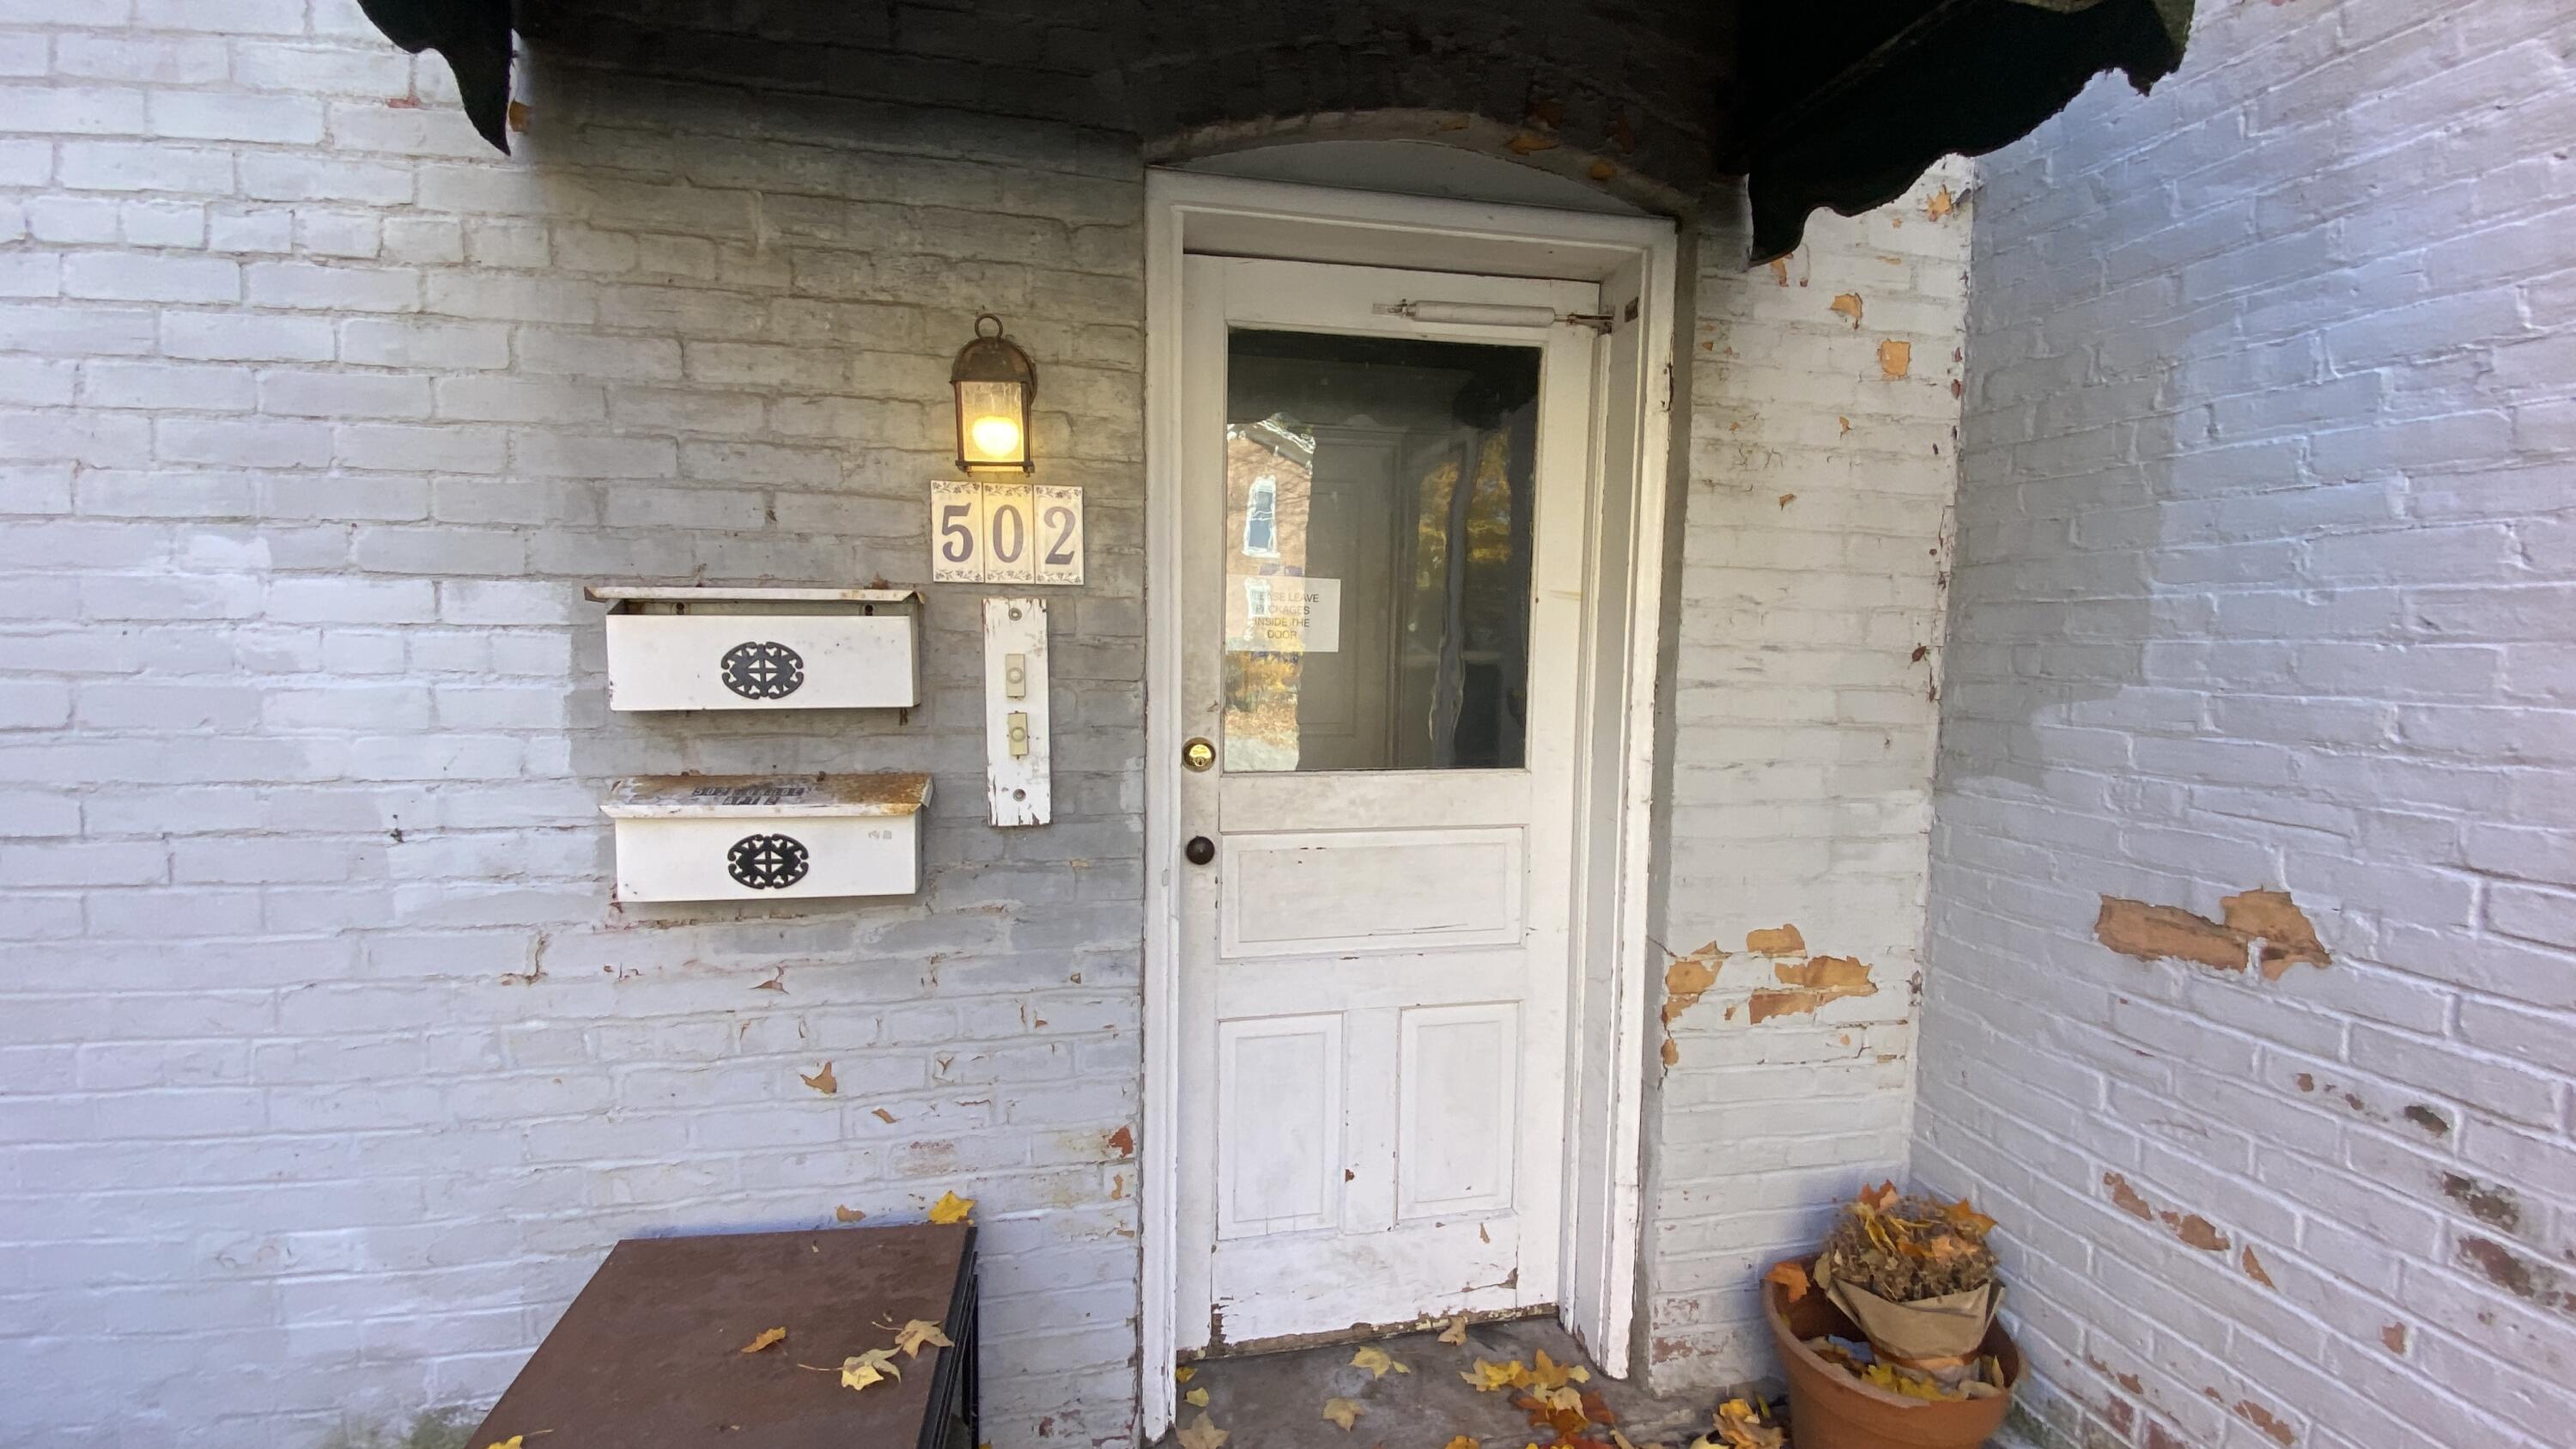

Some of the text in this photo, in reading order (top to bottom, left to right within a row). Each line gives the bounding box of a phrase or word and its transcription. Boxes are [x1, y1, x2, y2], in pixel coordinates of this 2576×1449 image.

[942, 502, 1076, 564] 502
[1251, 592, 1320, 603] EASE LEAVE
[1255, 618, 1310, 628] INSIDE THE
[1267, 630, 1297, 639] DOOR
